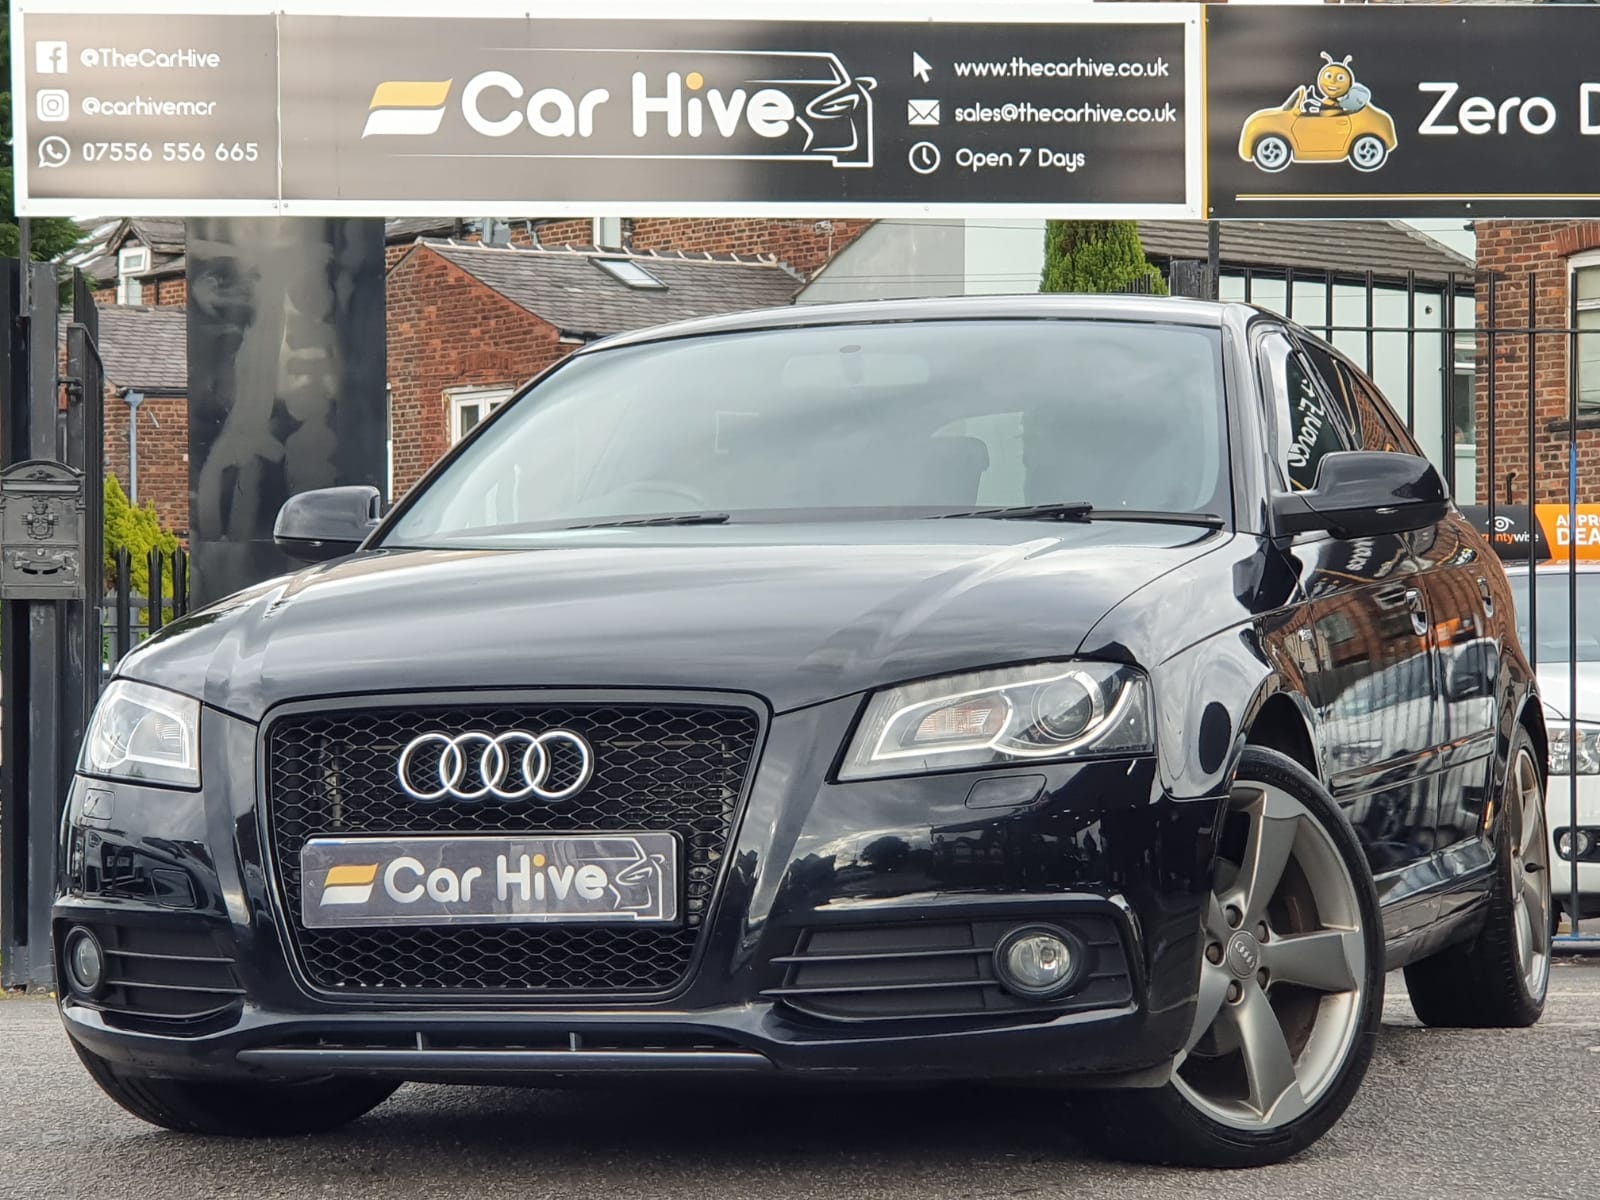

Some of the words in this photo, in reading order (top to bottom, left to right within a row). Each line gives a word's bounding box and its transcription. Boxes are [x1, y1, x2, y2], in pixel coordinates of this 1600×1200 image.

[80, 48, 220, 68] @TheCarHive
[954, 57, 1169, 77] www.thecarhive.co.uk
[82, 96, 216, 116] @carhivemcr
[461, 71, 610, 137] Car
[632, 71, 795, 137] Hive
[955, 102, 1176, 122] sales@thecarhive.co.uk
[1418, 82, 1557, 135] Zero
[83, 143, 152, 161] 07556
[162, 143, 206, 161] 556
[215, 143, 258, 161] 665
[955, 148, 1013, 172] Open
[1019, 148, 1032, 167] 7
[1038, 148, 1086, 172] Days
[1556, 514, 1600, 527] APR
[384, 857, 482, 903] Car
[496, 853, 609, 901] Hive
